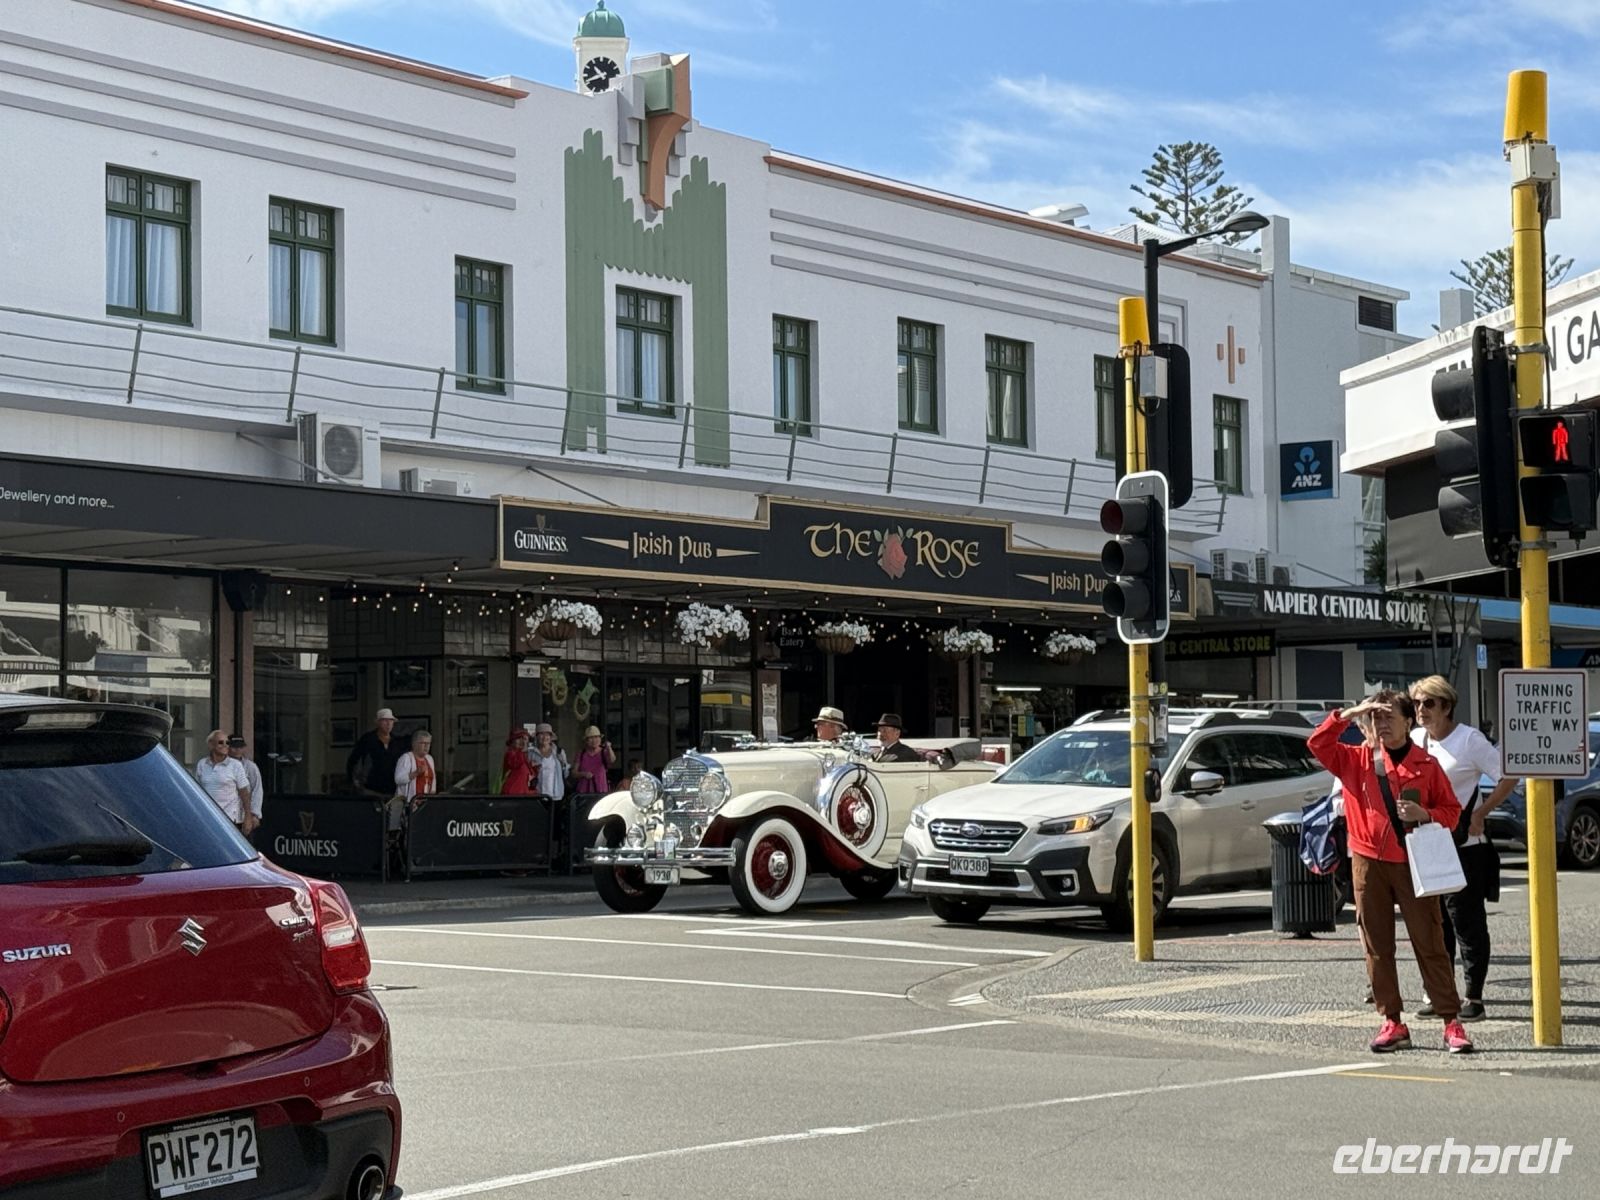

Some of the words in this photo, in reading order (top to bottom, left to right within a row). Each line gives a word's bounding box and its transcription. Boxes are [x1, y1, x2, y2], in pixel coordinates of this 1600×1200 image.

[1291, 473, 1322, 488] ANZ
[0, 487, 51, 506] Jewellery
[54, 494, 75, 505] and
[514, 530, 568, 552] GUINNESS
[633, 532, 673, 558] Irish
[1051, 570, 1080, 595] Irish
[1263, 590, 1318, 616] NAPIER
[1321, 595, 1383, 621] CENTRAL
[1385, 600, 1427, 624] STORE
[1179, 638, 1230, 655] CENTRAL
[1233, 635, 1271, 652] STORE
[1515, 683, 1574, 697] TURNING
[1516, 700, 1572, 715] TRAFFIC
[1509, 718, 1538, 731] GIVE
[1552, 718, 1579, 731] WAY
[1536, 735, 1552, 749] TO
[1507, 753, 1582, 765] PEDESTRIANS
[445, 820, 500, 837] GUINNESS
[274, 835, 338, 857] GUINNESS
[2, 943, 72, 963] SUZUKI
[149, 1124, 256, 1185] PWF272
